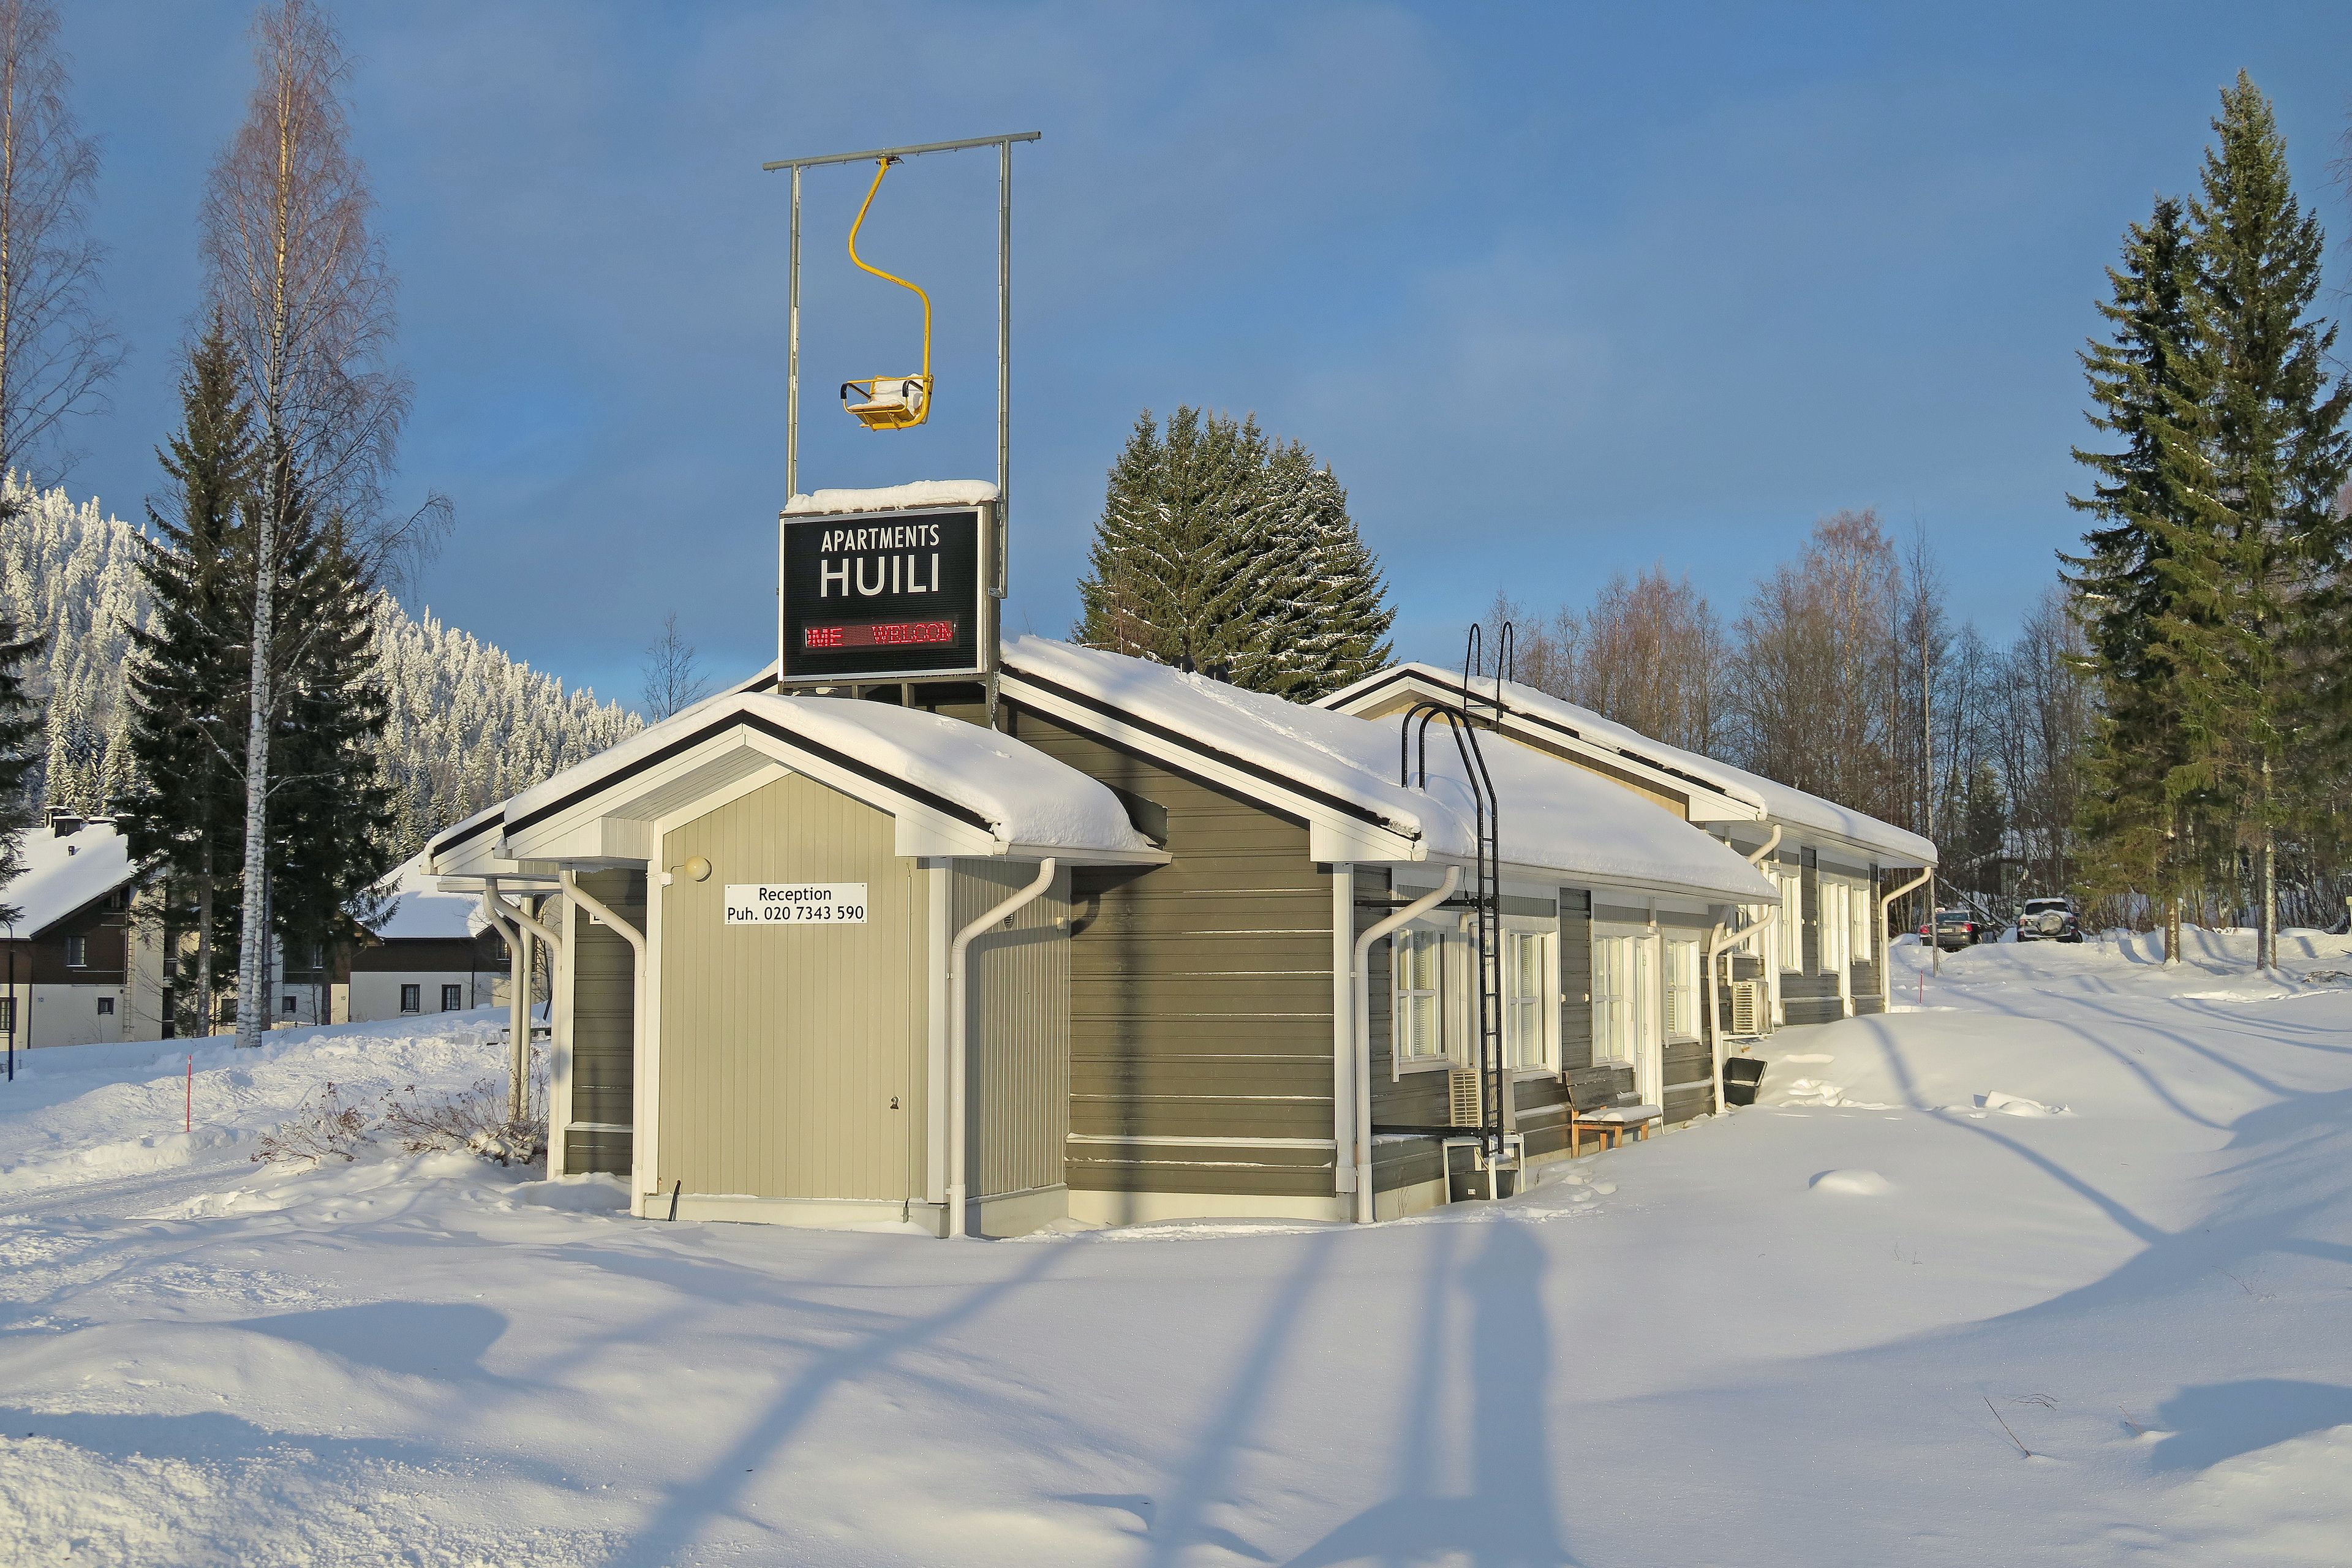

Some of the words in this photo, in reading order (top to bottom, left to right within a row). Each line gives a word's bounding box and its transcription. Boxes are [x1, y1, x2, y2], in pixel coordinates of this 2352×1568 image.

[821, 524, 940, 552] APARTMENTS
[821, 553, 938, 597] HUILI
[759, 887, 832, 904] Reception
[728, 907, 758, 921] Puh.
[764, 906, 791, 921] 020
[796, 905, 831, 920] 7343
[837, 905, 864, 920] 590
